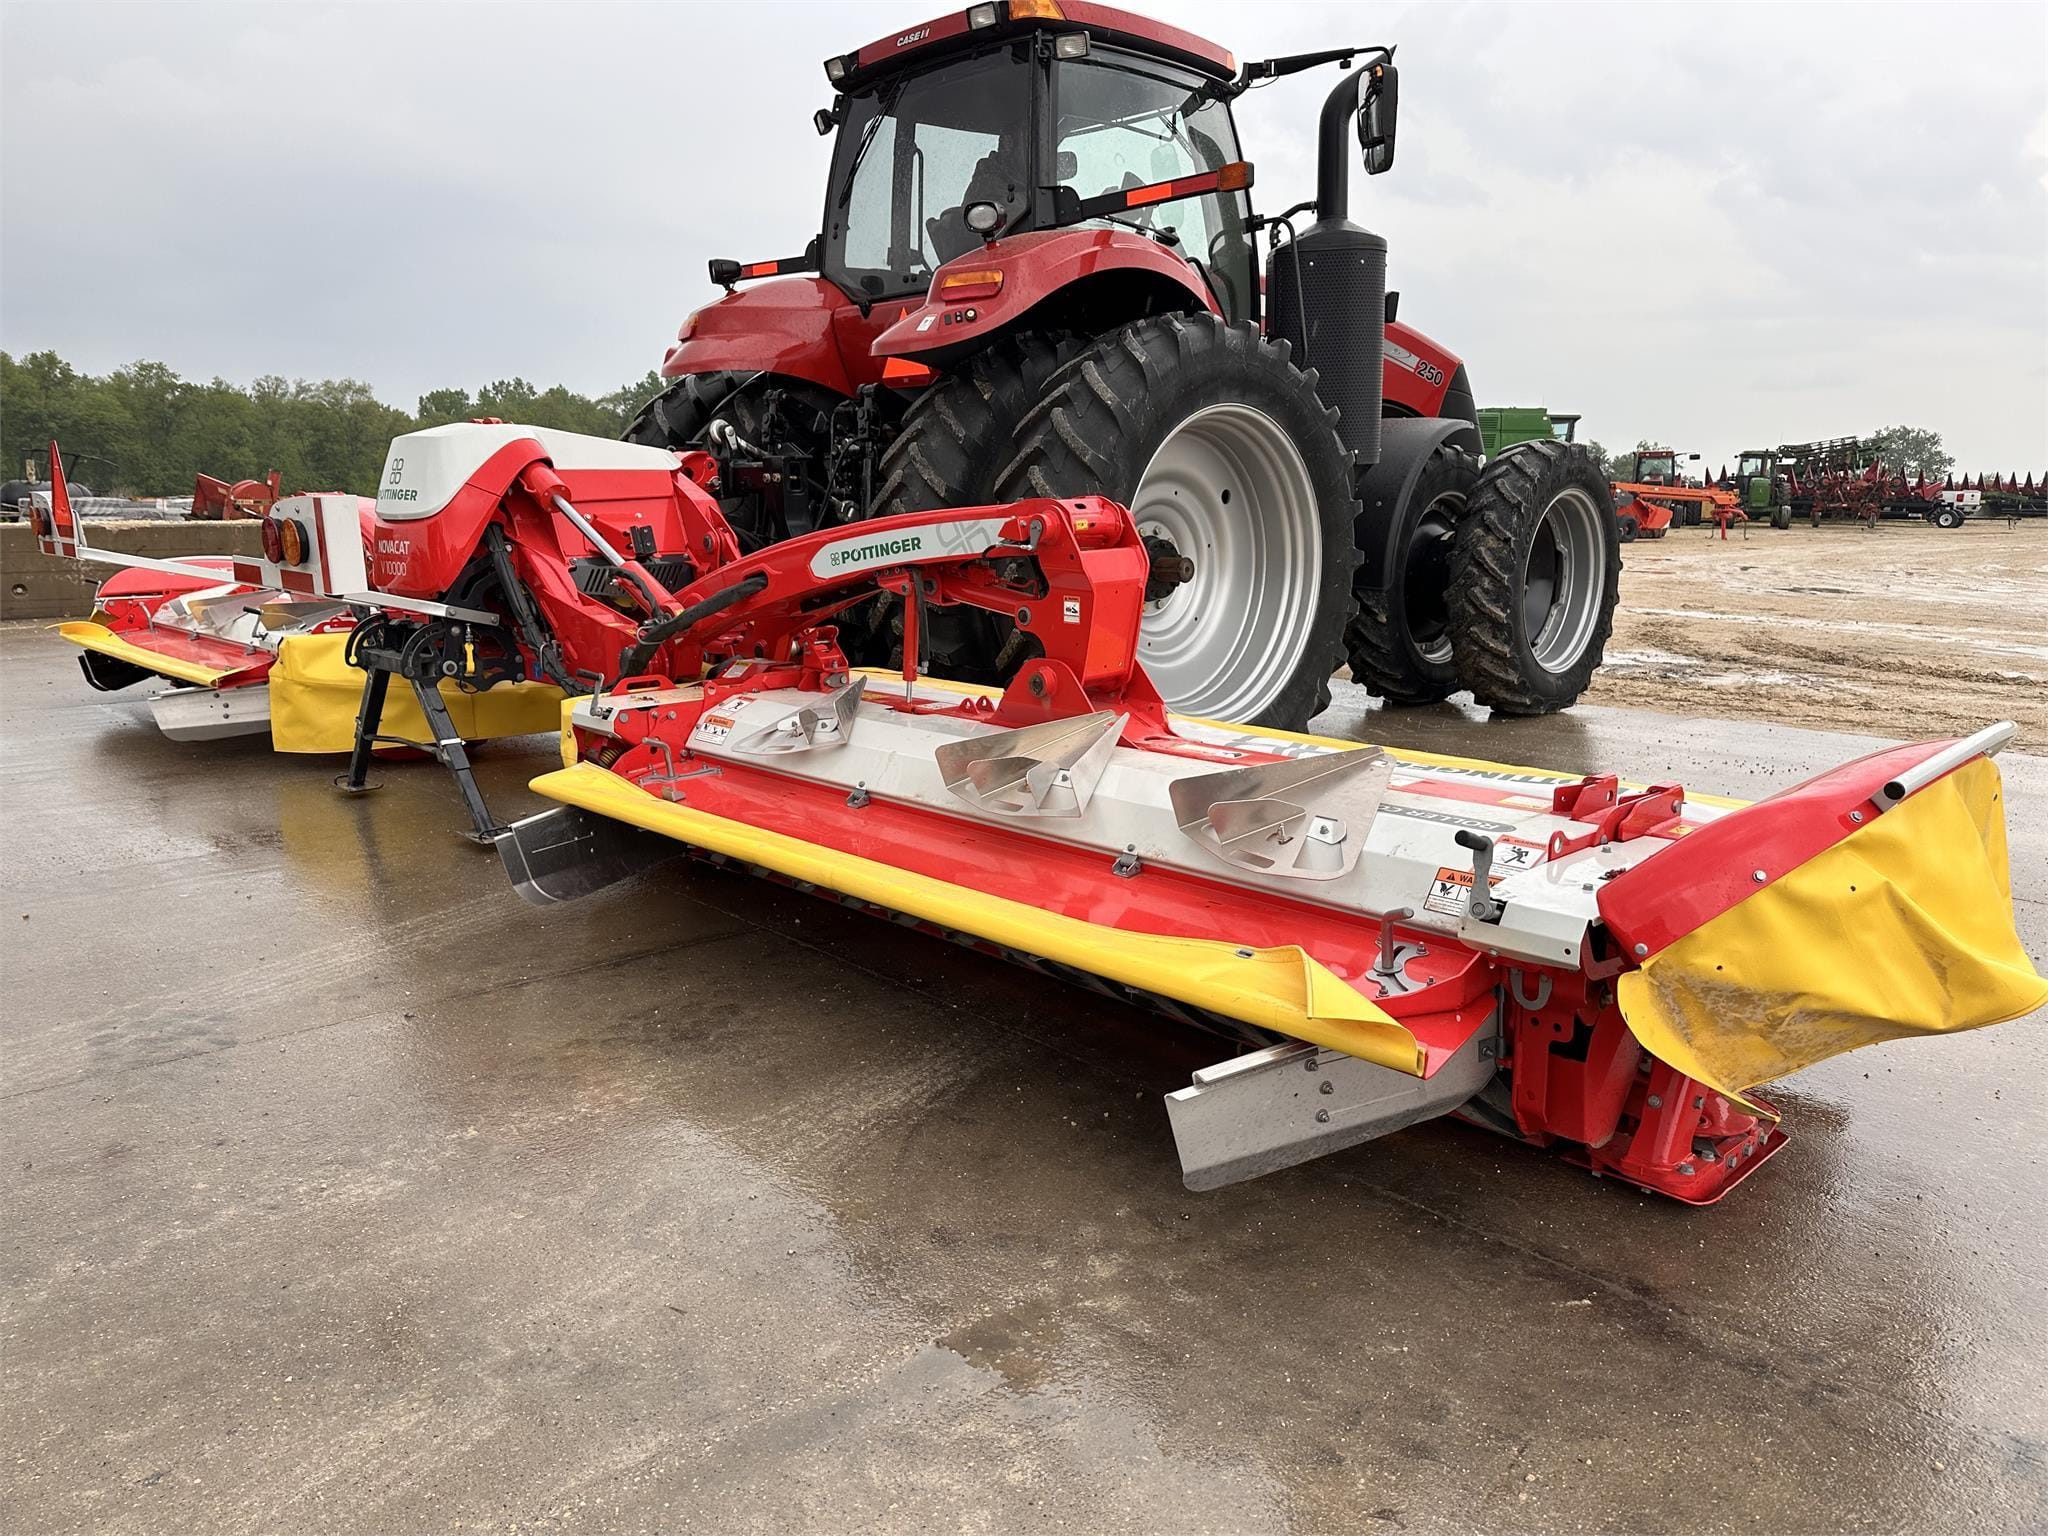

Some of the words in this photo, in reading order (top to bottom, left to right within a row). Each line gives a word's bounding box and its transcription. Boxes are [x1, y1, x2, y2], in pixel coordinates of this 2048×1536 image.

[1415, 360, 1444, 387] 250
[378, 540, 410, 555] NOVACAT
[1405, 808, 1499, 830] ROLLER
